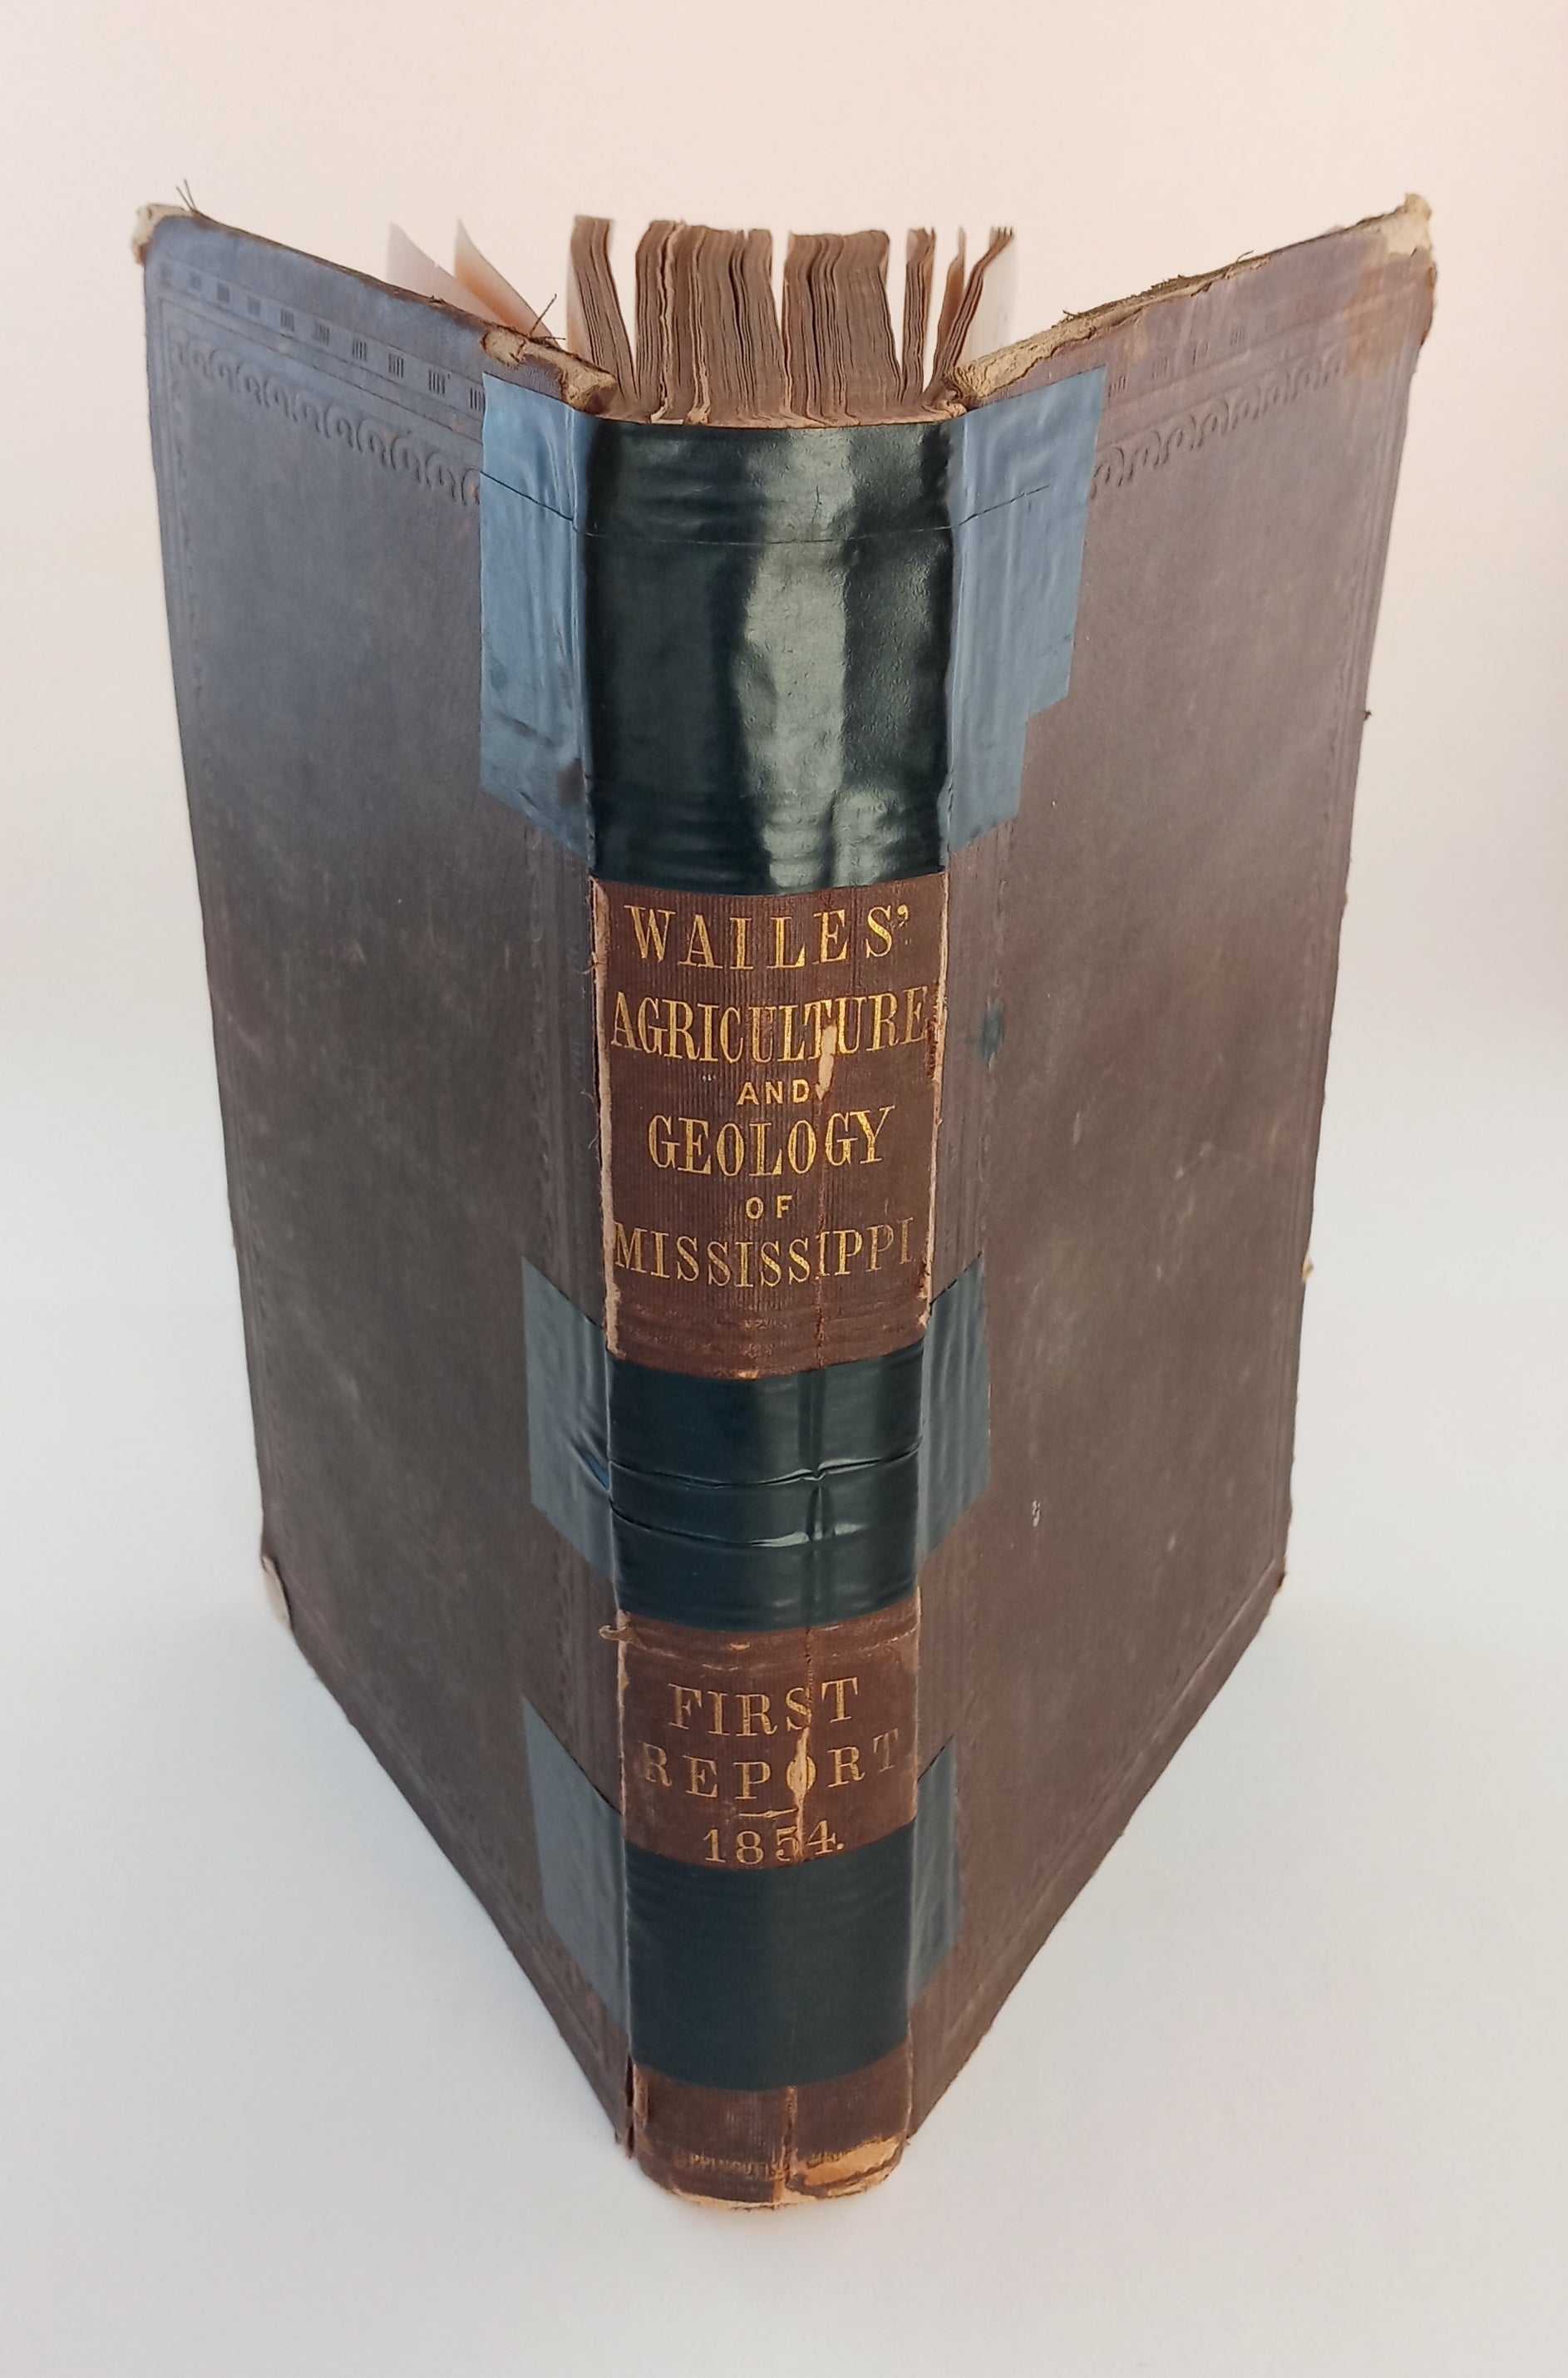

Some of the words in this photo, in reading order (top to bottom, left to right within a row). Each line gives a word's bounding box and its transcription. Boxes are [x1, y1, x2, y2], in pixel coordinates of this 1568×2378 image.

[624, 904, 909, 969] WAILES'
[611, 985, 929, 1063] AGRICULTURE
[737, 1079, 810, 1106] AND
[648, 1105, 895, 1177] GEOLOGY
[746, 1195, 793, 1219] OF
[614, 1217, 914, 1287] MISSISSIPPI
[668, 1677, 859, 1736] FIRST
[638, 1728, 899, 1799] REPORT
[703, 1820, 845, 1864] 1854.
